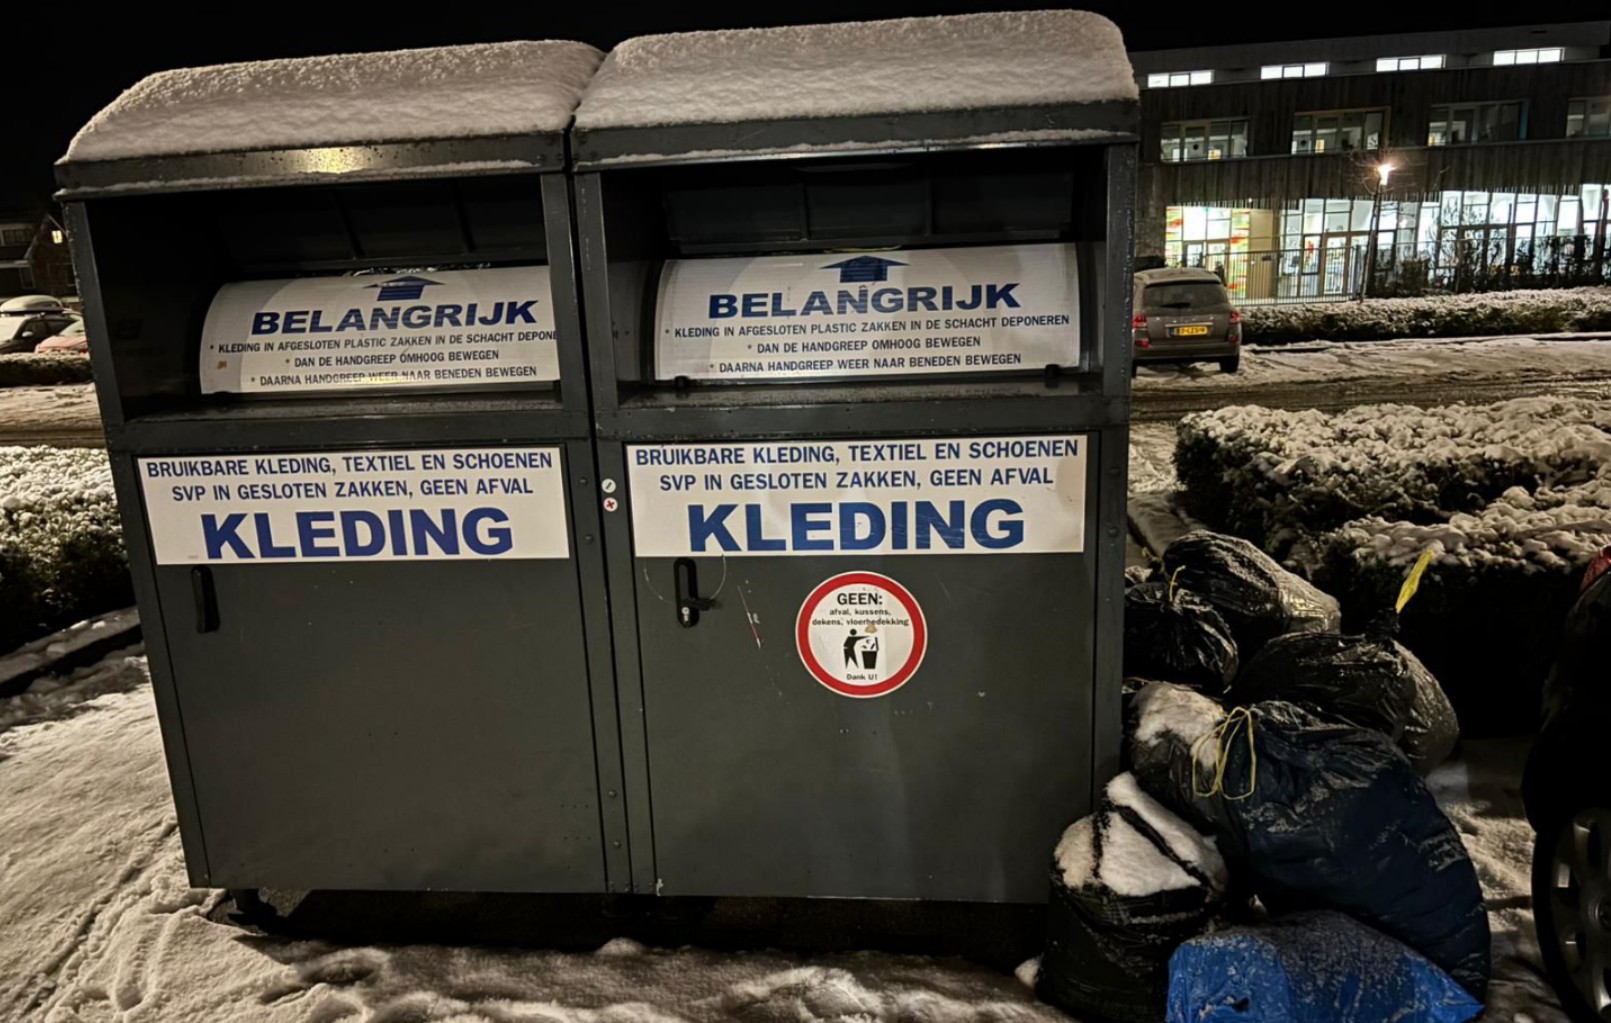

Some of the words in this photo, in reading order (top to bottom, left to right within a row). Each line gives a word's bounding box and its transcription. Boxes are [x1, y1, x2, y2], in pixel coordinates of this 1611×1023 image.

[708, 283, 1022, 319] BELANGRIJK
[251, 300, 538, 335] BELANGRIJK
[674, 327, 720, 338] KLEDING
[724, 326, 734, 336] IN
[738, 324, 807, 336] AFGESLOTEN
[811, 322, 857, 334] PLASTIC
[861, 321, 906, 332] ZAKKEN
[910, 320, 922, 330] IN
[926, 319, 941, 330] DE
[945, 317, 997, 329] SCHACHT
[1001, 315, 1070, 327] DEPONEREN
[218, 343, 260, 354] KLEDING
[264, 342, 274, 352] IN
[278, 340, 340, 351] AFGESLOTEN
[344, 338, 387, 349] PLASTIC
[390, 336, 431, 347] ZAKKEN
[435, 335, 446, 345] IN
[450, 334, 463, 344] DE
[466, 332, 514, 343] SCHACHT
[757, 343, 779, 354] DAN
[783, 342, 797, 353] DE
[802, 340, 867, 352] HANDGREEP
[872, 338, 921, 350] OMHOOG
[926, 336, 981, 348] BEWEGEN
[294, 357, 315, 367] DAN
[318, 356, 332, 366] DE
[336, 354, 396, 366] HANDGREEP
[400, 352, 445, 363] OMHOOG
[450, 350, 499, 361] BEWEGEN
[719, 362, 764, 373] DAARNA
[768, 359, 833, 371] HANDGREEP
[837, 358, 869, 369] WEER
[873, 357, 905, 368] NAAR
[909, 355, 961, 367] BENEDEN
[965, 354, 1021, 366] BEWEGEN
[260, 375, 301, 386] DAARNA
[305, 373, 365, 385] HANDGREEP
[401, 370, 430, 380] NAAR
[435, 368, 482, 379] BENEDEN
[486, 366, 537, 377] BEWEGEN
[636, 447, 746, 466] BRUIKBARE
[753, 446, 840, 464] KLEDING,
[848, 444, 927, 462] TEXTIEL
[935, 443, 961, 460] EN
[969, 440, 1078, 460] SCHOENEN
[146, 459, 249, 478] BRUIKBARE
[255, 457, 337, 476] KLEDING,
[342, 455, 415, 473] TEXTIEL
[422, 454, 446, 471] EN
[453, 452, 553, 470] SCHOENEN
[172, 485, 206, 502] SVP
[213, 484, 231, 501] IN
[237, 481, 327, 500] GESLOTEN
[335, 480, 413, 499] ZAKKEN,
[420, 478, 468, 496] GEEN
[476, 478, 533, 495] AFVAL
[659, 474, 697, 491] SVP
[704, 474, 722, 491] IN
[730, 472, 827, 491] GESLOTEN
[836, 470, 922, 489] ZAKKEN,
[930, 469, 982, 486] GEEN
[990, 468, 1054, 486] AFVAL
[201, 507, 513, 559] KLEDING
[688, 499, 1025, 552] KLEDING
[837, 593, 883, 605] GEEN:
[812, 618, 843, 626] dekens,
[829, 608, 852, 616] afval,
[854, 608, 891, 616] kussens,
